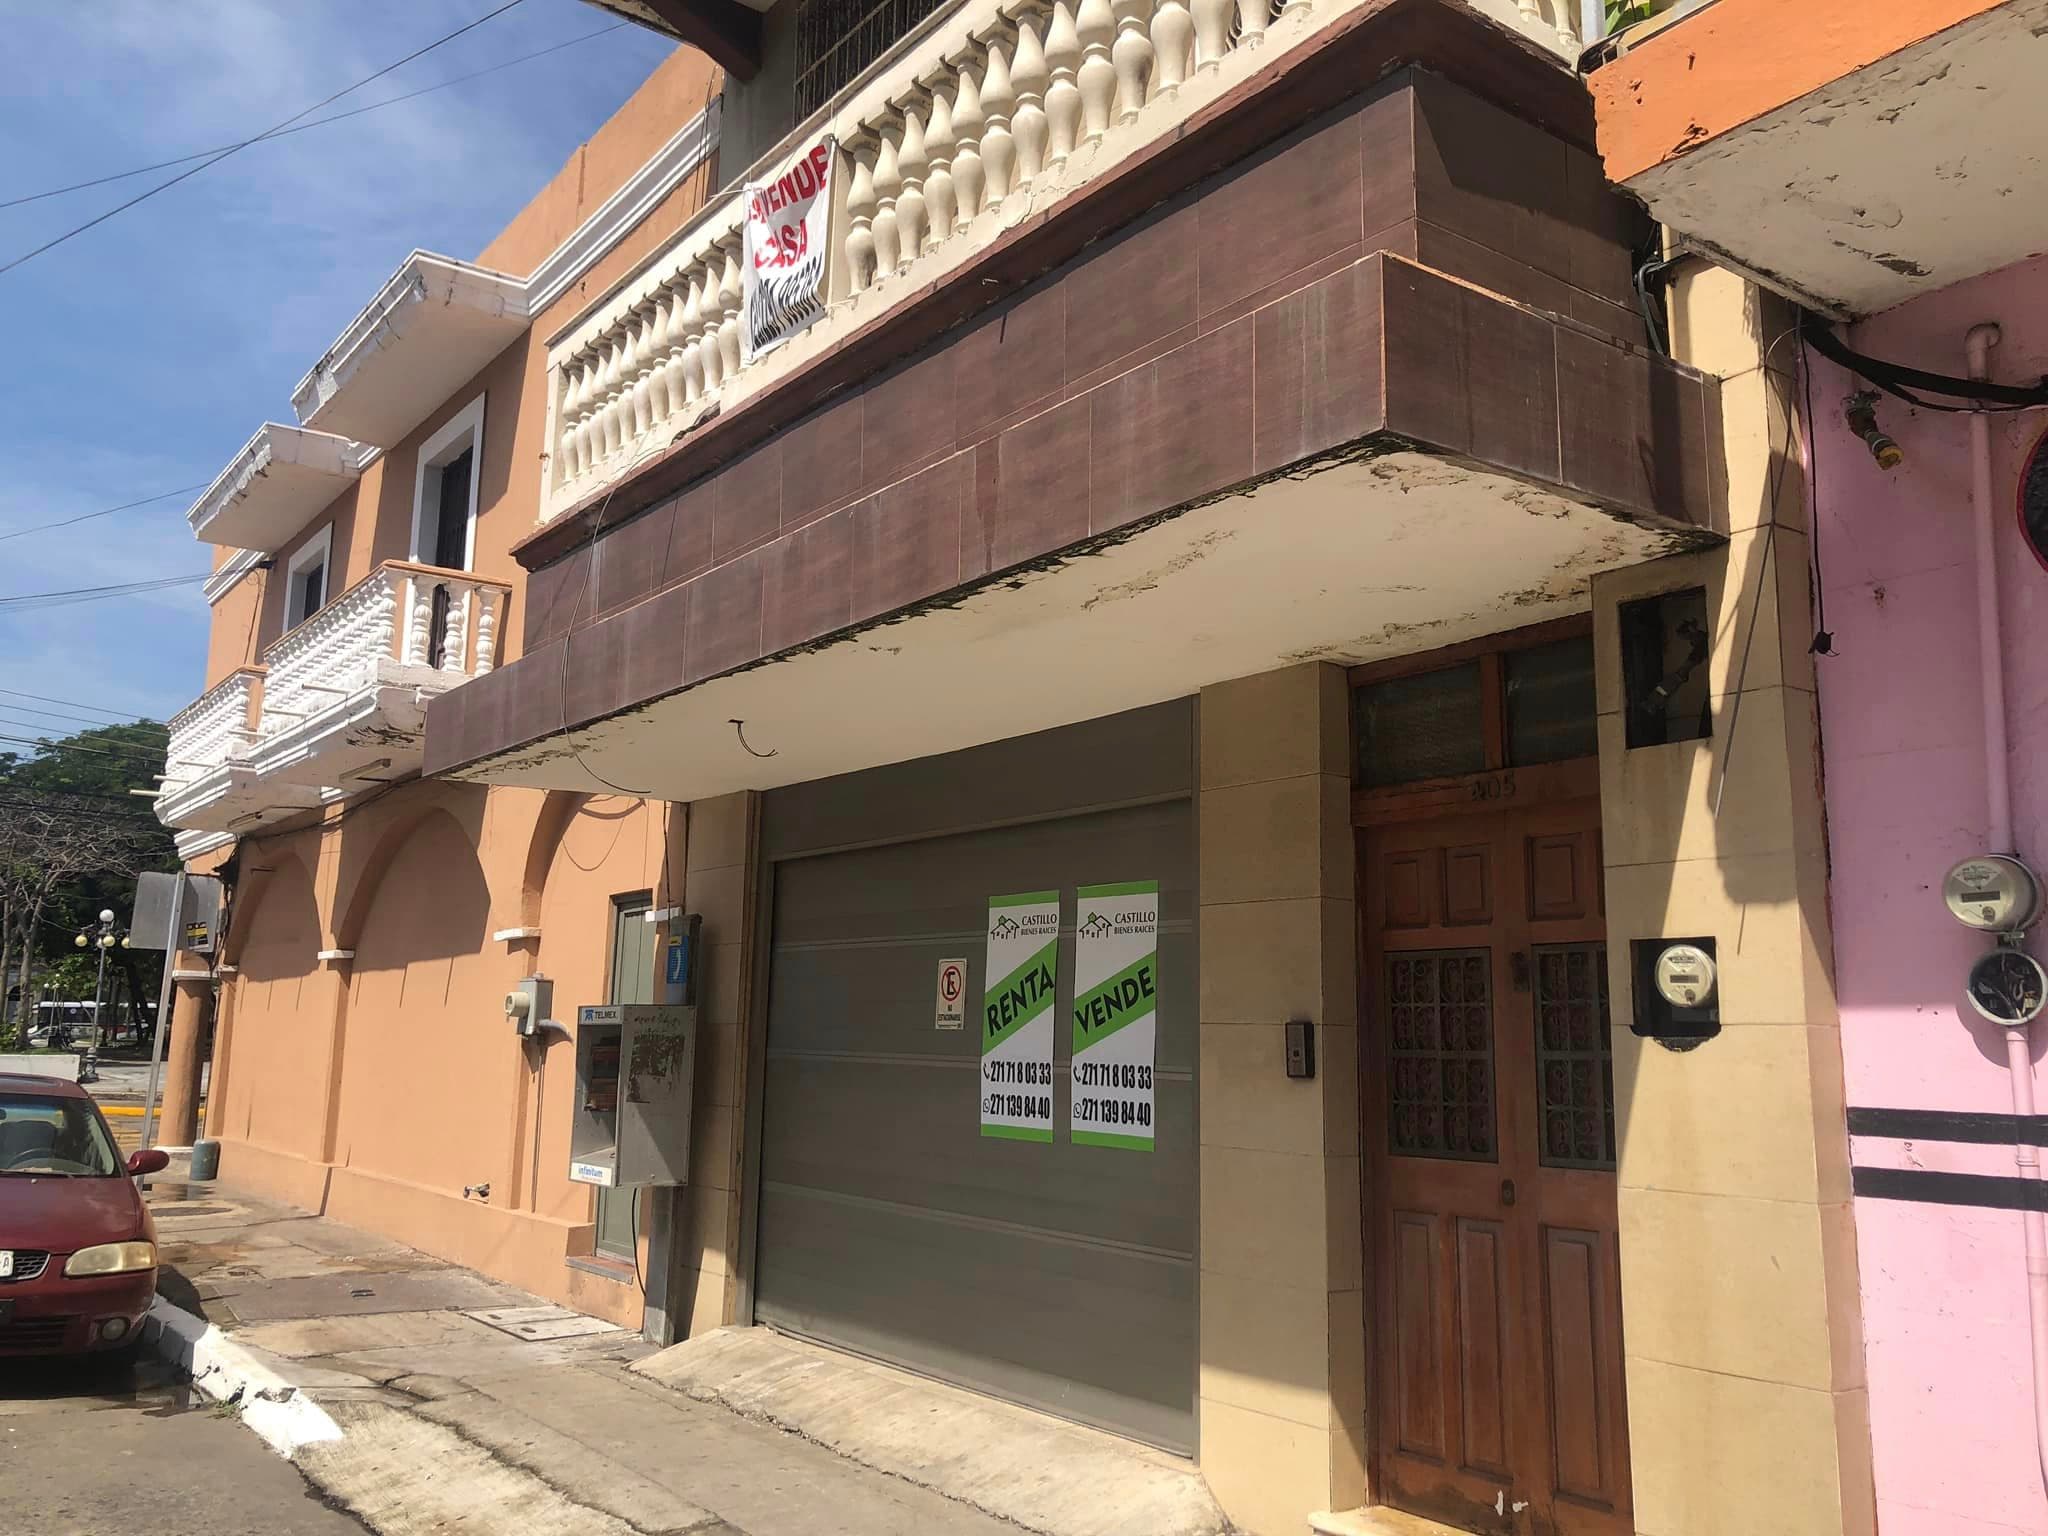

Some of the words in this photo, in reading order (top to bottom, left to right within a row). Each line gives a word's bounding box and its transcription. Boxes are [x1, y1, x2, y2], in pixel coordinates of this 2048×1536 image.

[760, 144, 828, 218] VENDE
[1021, 913, 1057, 926] CASTILLO
[1114, 911, 1156, 924] CASTILLO
[1114, 926, 1134, 935] BIENES
[1134, 925, 1155, 934] RAICES
[1021, 928, 1038, 936] BIENES
[1039, 926, 1057, 935] RAICES
[987, 961, 1055, 1038] RENTA
[1074, 966, 1155, 1035] VENDE
[595, 1010, 617, 1019] TELMEX
[990, 1060, 1005, 1082] 271
[1025, 1062, 1037, 1085] 03
[1039, 1062, 1051, 1085] 33
[1081, 1062, 1098, 1086] 271
[1121, 1064, 1135, 1089] 03
[1137, 1065, 1152, 1090] 33
[990, 1093, 1005, 1116] 271
[1006, 1094, 1022, 1117] 139
[1024, 1095, 1036, 1118] 84
[1038, 1096, 1050, 1119] 40
[1081, 1097, 1098, 1121] 271
[1100, 1099, 1119, 1124] 139
[1121, 1100, 1135, 1125] 84
[1137, 1102, 1151, 1127] 40
